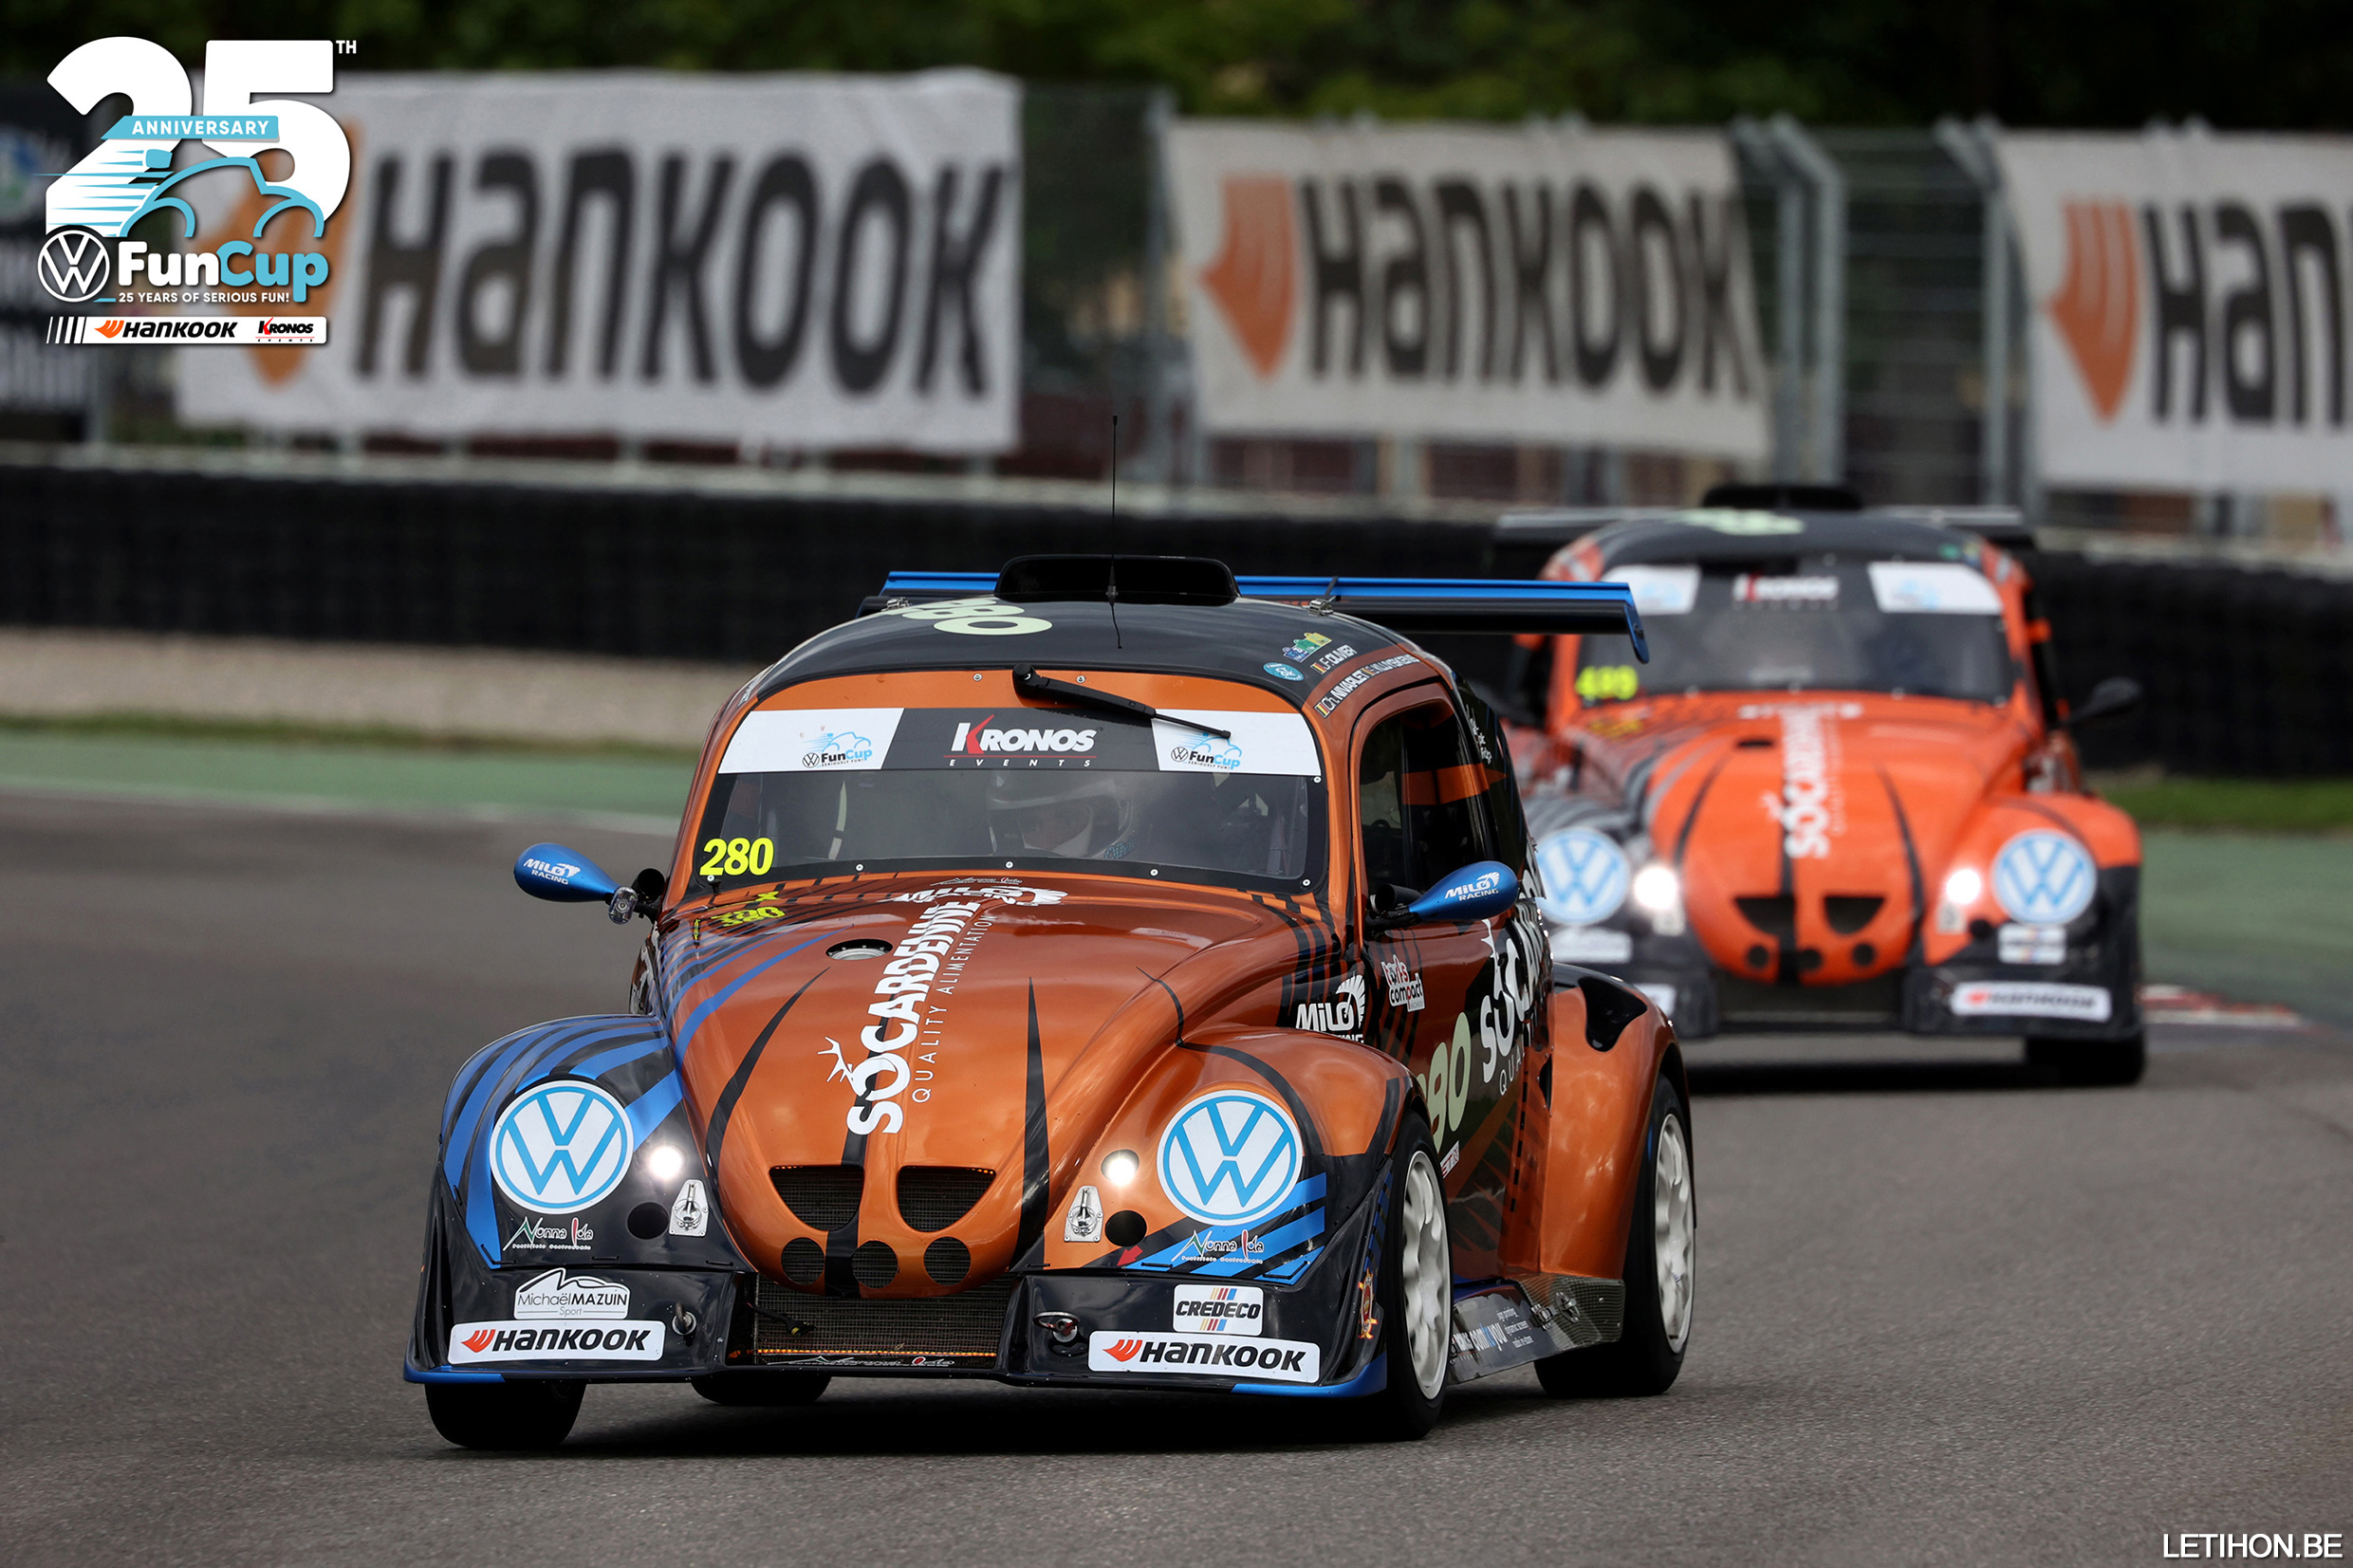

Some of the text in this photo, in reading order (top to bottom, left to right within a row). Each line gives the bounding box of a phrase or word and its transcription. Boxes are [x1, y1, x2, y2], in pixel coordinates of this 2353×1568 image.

[951, 714, 1098, 754] KRONOS
[821, 749, 872, 763] FunCup
[1190, 751, 1241, 770] FunCup
[699, 838, 774, 876] 280
[531, 869, 569, 885] RACING
[1458, 888, 1499, 901] RACING
[846, 900, 982, 1135] SOCARDENNE
[911, 913, 997, 1103] QUALITY ALIMENTATION
[1417, 1011, 1472, 1154] 80
[502, 1216, 567, 1251] Nonna
[1171, 1229, 1237, 1263] Nonna
[559, 1306, 583, 1318] Sport
[1176, 1300, 1262, 1319] CREDECO
